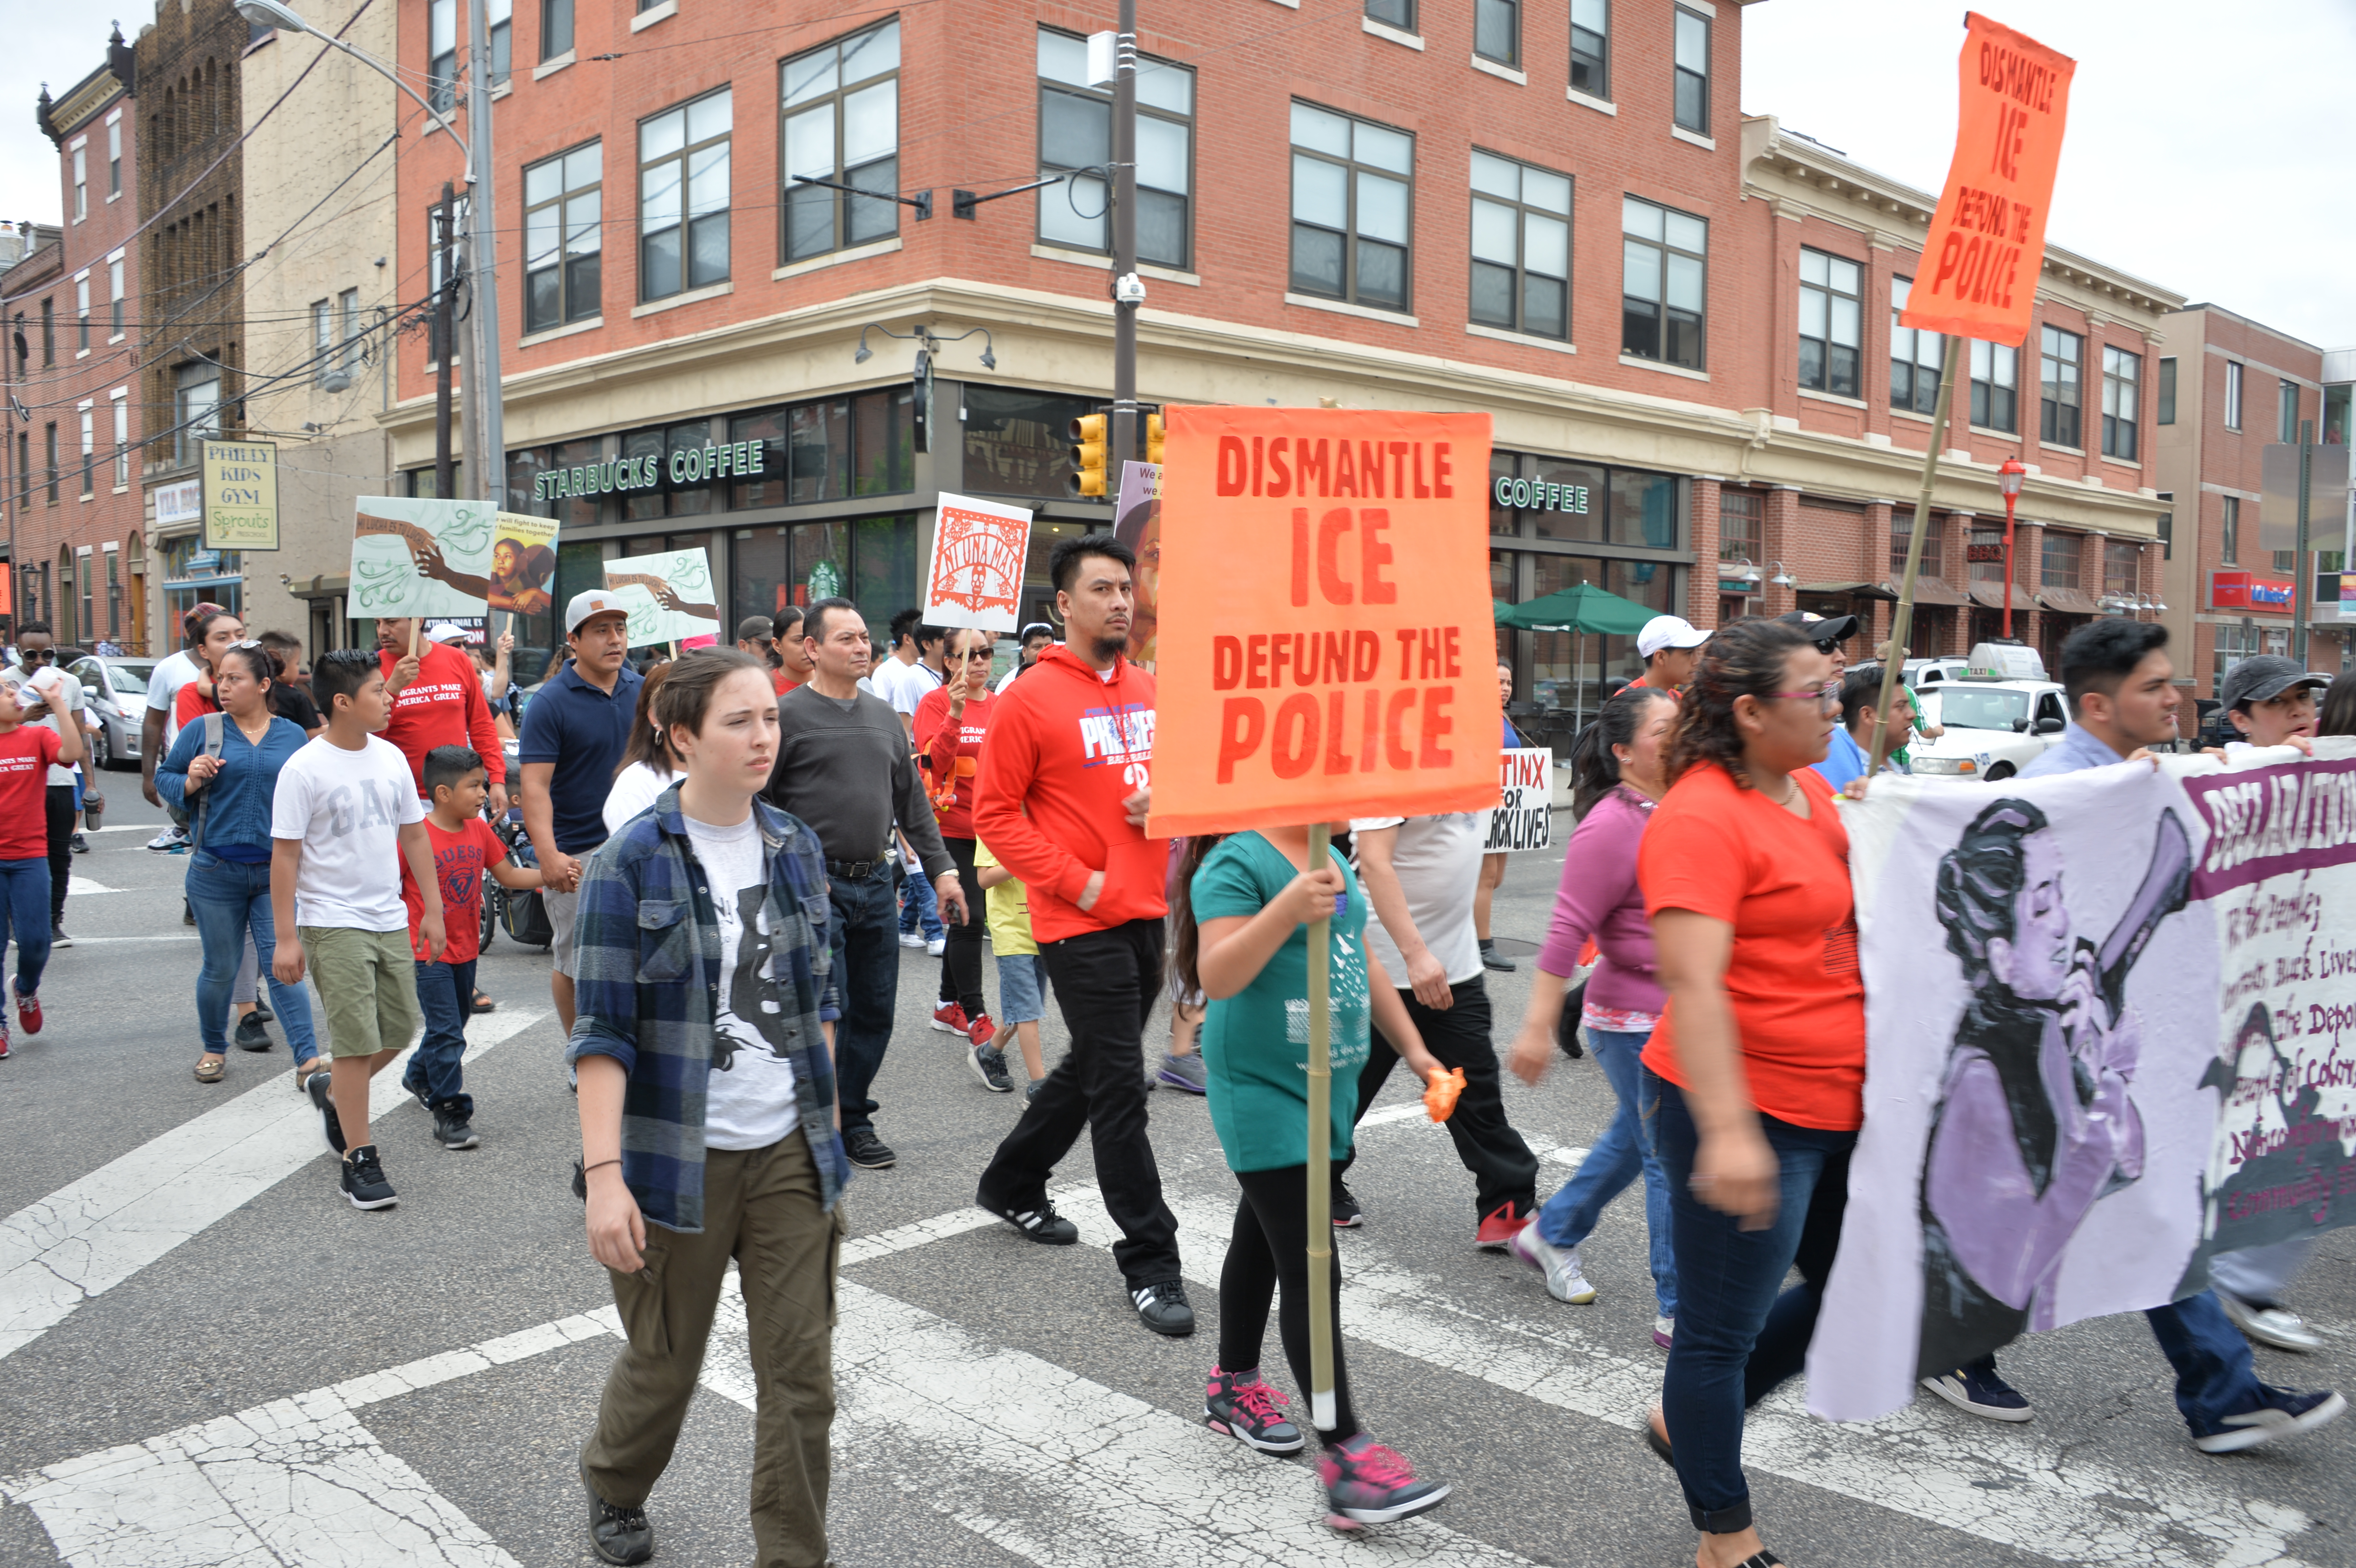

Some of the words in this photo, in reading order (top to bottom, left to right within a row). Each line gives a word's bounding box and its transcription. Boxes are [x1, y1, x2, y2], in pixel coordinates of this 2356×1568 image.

[1979, 41, 2056, 115] DISMANTLE
[1991, 101, 2028, 183] ICE
[1951, 185, 2008, 237] DEFUND
[2010, 202, 2033, 245] THE
[1931, 231, 2021, 309] POLICE
[208, 446, 270, 462] PHILLY
[221, 467, 261, 482] KIDS
[534, 455, 658, 501] STARBUCKS
[670, 439, 764, 483] COFFEE
[1140, 468, 1155, 479] We
[1215, 436, 1453, 499] DISMANTLE
[221, 488, 260, 504] GYM
[1143, 487, 1157, 495] we
[1495, 477, 1588, 514] COFFEE
[213, 511, 269, 530] Sprouts
[367, 519, 388, 531] LUCHA
[389, 521, 397, 532] ES
[399, 523, 407, 536] TU
[405, 525, 427, 547] LUCHA
[499, 525, 524, 534] families
[526, 529, 556, 538] together.
[539, 523, 555, 531] keep
[944, 543, 959, 575] NI
[963, 535, 988, 566] UNA
[991, 539, 1018, 580] MAS
[1291, 507, 1397, 607] ICE
[1967, 545, 2004, 561] BBQ
[608, 577, 614, 586] MI
[615, 576, 631, 585] LUCHA
[638, 575, 645, 584] TU
[645, 577, 661, 590] LUCHA
[473, 618, 482, 627] ES
[1213, 630, 1380, 691] DEFUND
[1396, 626, 1461, 680] THE
[433, 692, 460, 701] GREAT
[1215, 686, 1454, 784] POLICE
[1513, 803, 1551, 850] LIVES
[434, 845, 482, 868] GUESS
